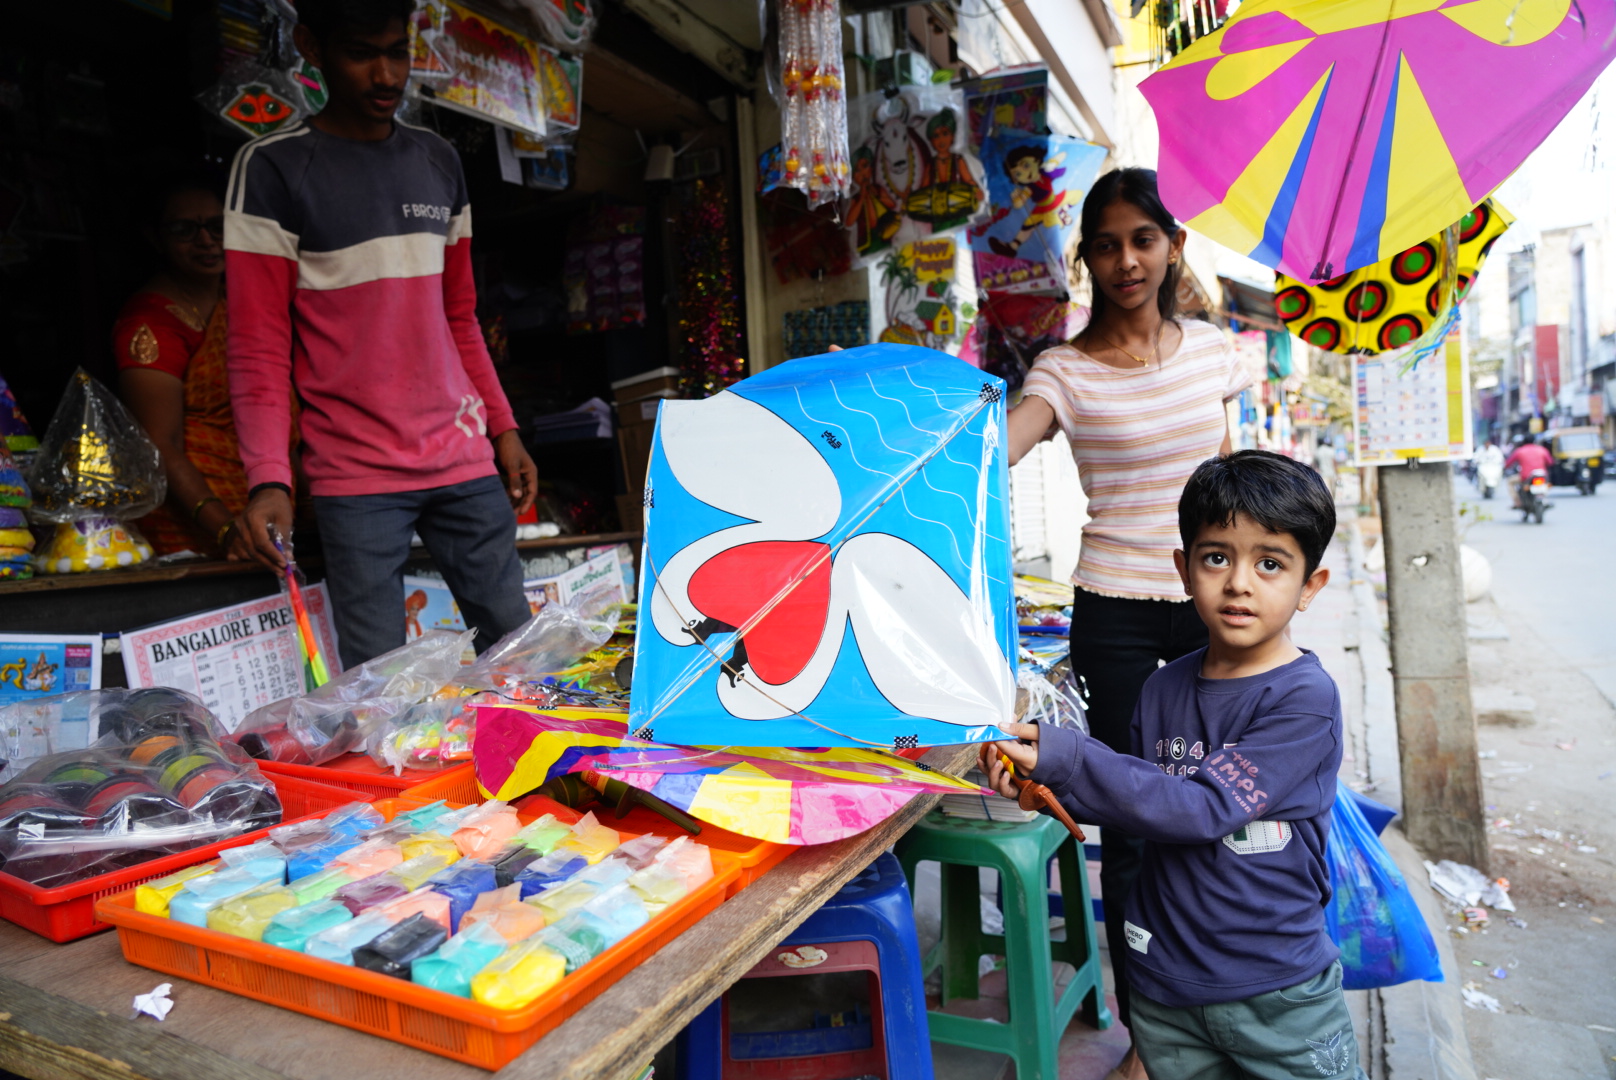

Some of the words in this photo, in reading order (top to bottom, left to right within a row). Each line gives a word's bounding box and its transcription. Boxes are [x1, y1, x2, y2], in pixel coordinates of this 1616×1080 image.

[402, 204, 411, 218] F
[411, 203, 441, 220] BROS
[151, 617, 254, 664] BANGALORE
[232, 650, 239, 660] 4
[245, 644, 257, 656] 11
[261, 640, 275, 651] 18
[276, 635, 291, 647] 25
[235, 663, 243, 674] 5
[248, 657, 261, 669] 12
[265, 652, 277, 664] 19
[238, 675, 246, 686] 6
[251, 669, 265, 681] 13
[267, 664, 280, 676] 20
[240, 687, 248, 698] 7
[254, 681, 266, 693] 14
[269, 676, 282, 689] 21
[284, 670, 297, 683] 28
[243, 699, 251, 710] 8
[255, 692, 269, 704] 15
[271, 687, 285, 700] 22
[287, 681, 299, 695] 29
[230, 717, 238, 728] 2
[1206, 766, 1231, 788] ENJOY
[1231, 789, 1252, 813] YOUR
[1309, 1053, 1338, 1076] FASHION
